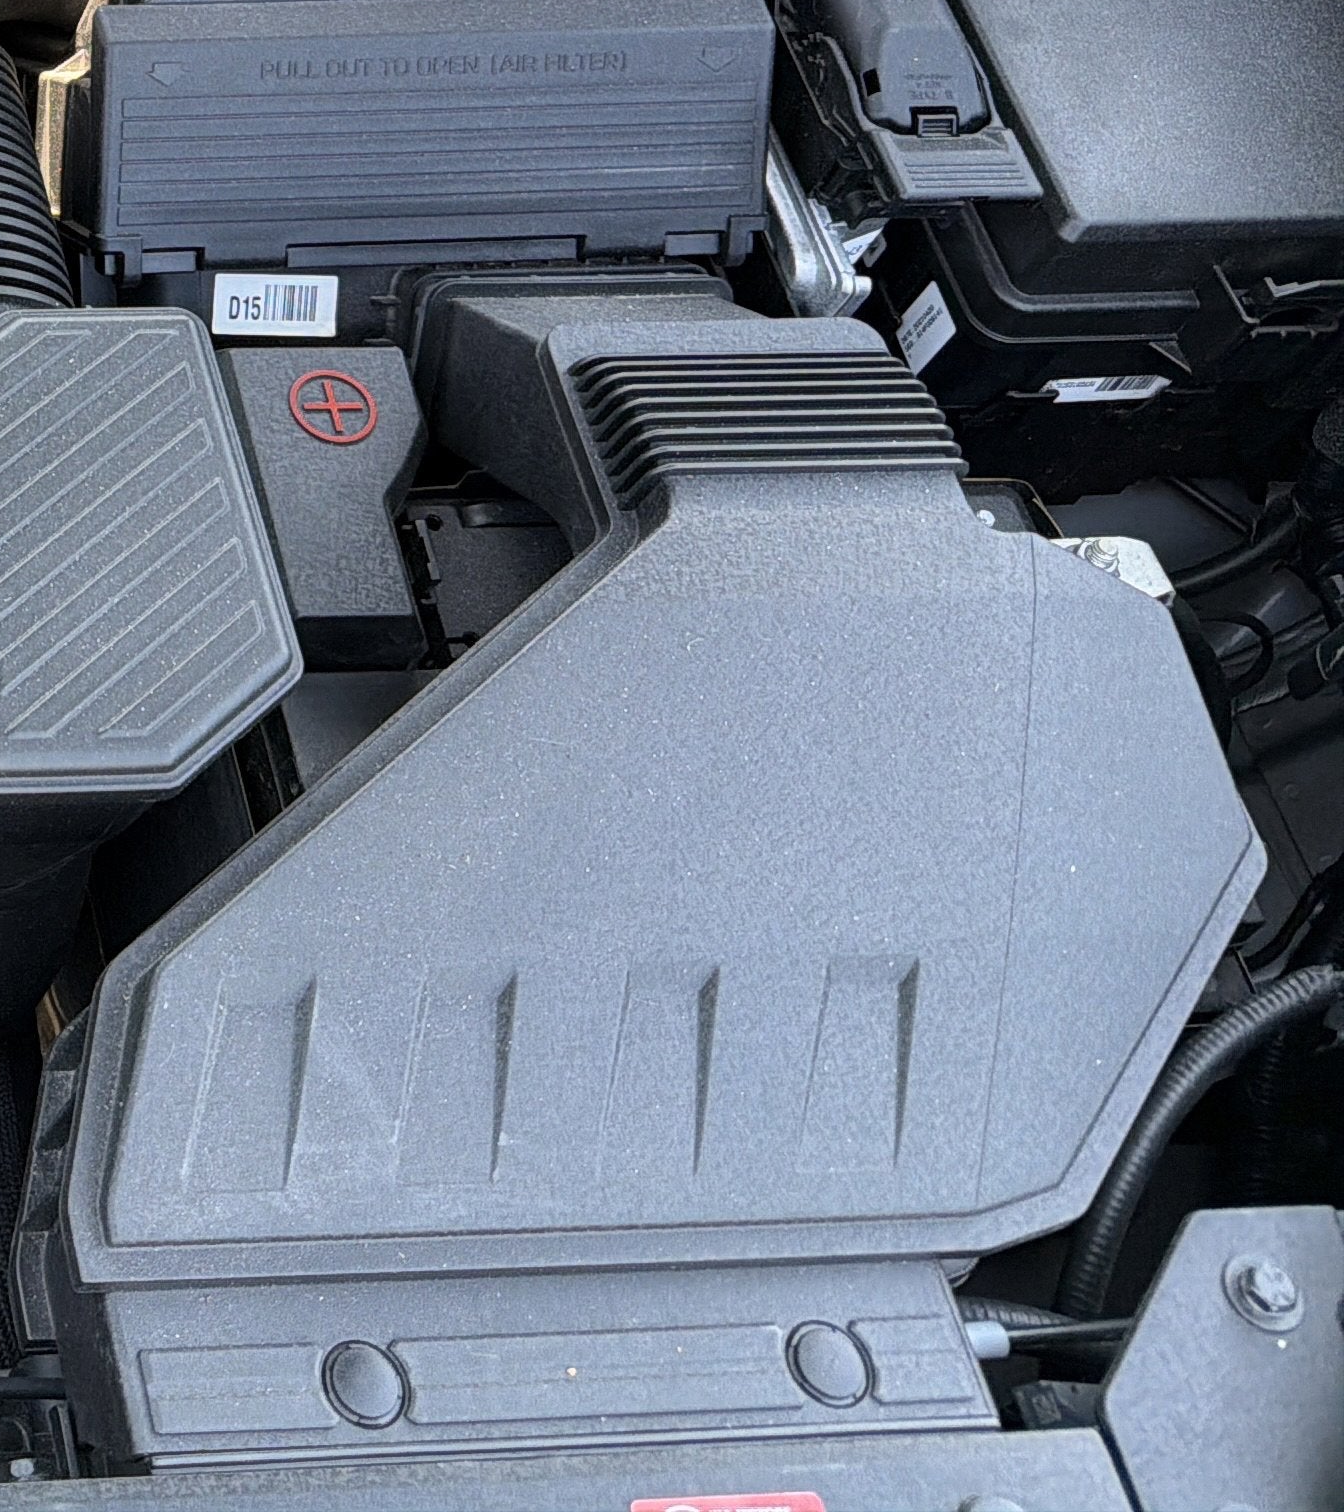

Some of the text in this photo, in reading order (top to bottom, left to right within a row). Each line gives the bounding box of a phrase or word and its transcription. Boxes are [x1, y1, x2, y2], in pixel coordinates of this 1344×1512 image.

[260, 59, 320, 79] PULL
[326, 58, 370, 79] OUT
[378, 57, 408, 77] TO
[416, 55, 480, 76] OPEN
[229, 295, 261, 321] D15
